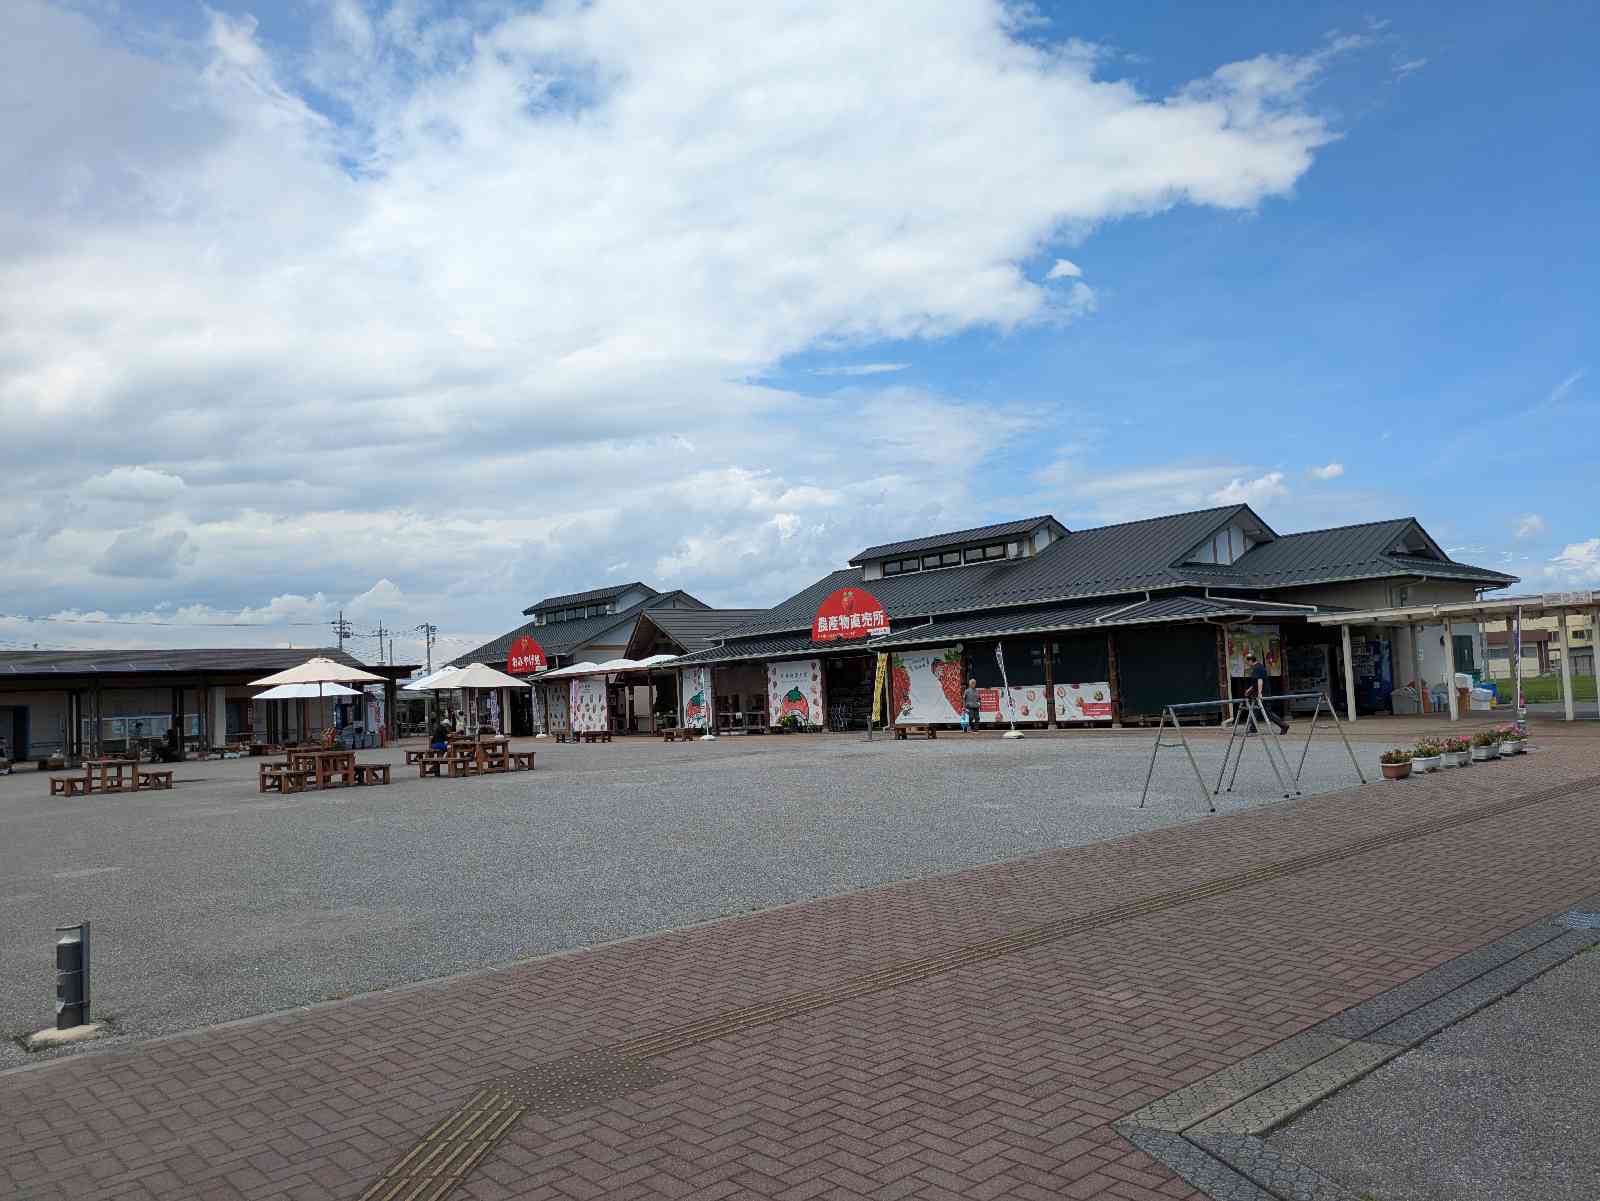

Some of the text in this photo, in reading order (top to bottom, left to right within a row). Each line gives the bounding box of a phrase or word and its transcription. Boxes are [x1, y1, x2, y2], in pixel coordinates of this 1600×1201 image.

[818, 610, 884, 633] 農産物直売所
